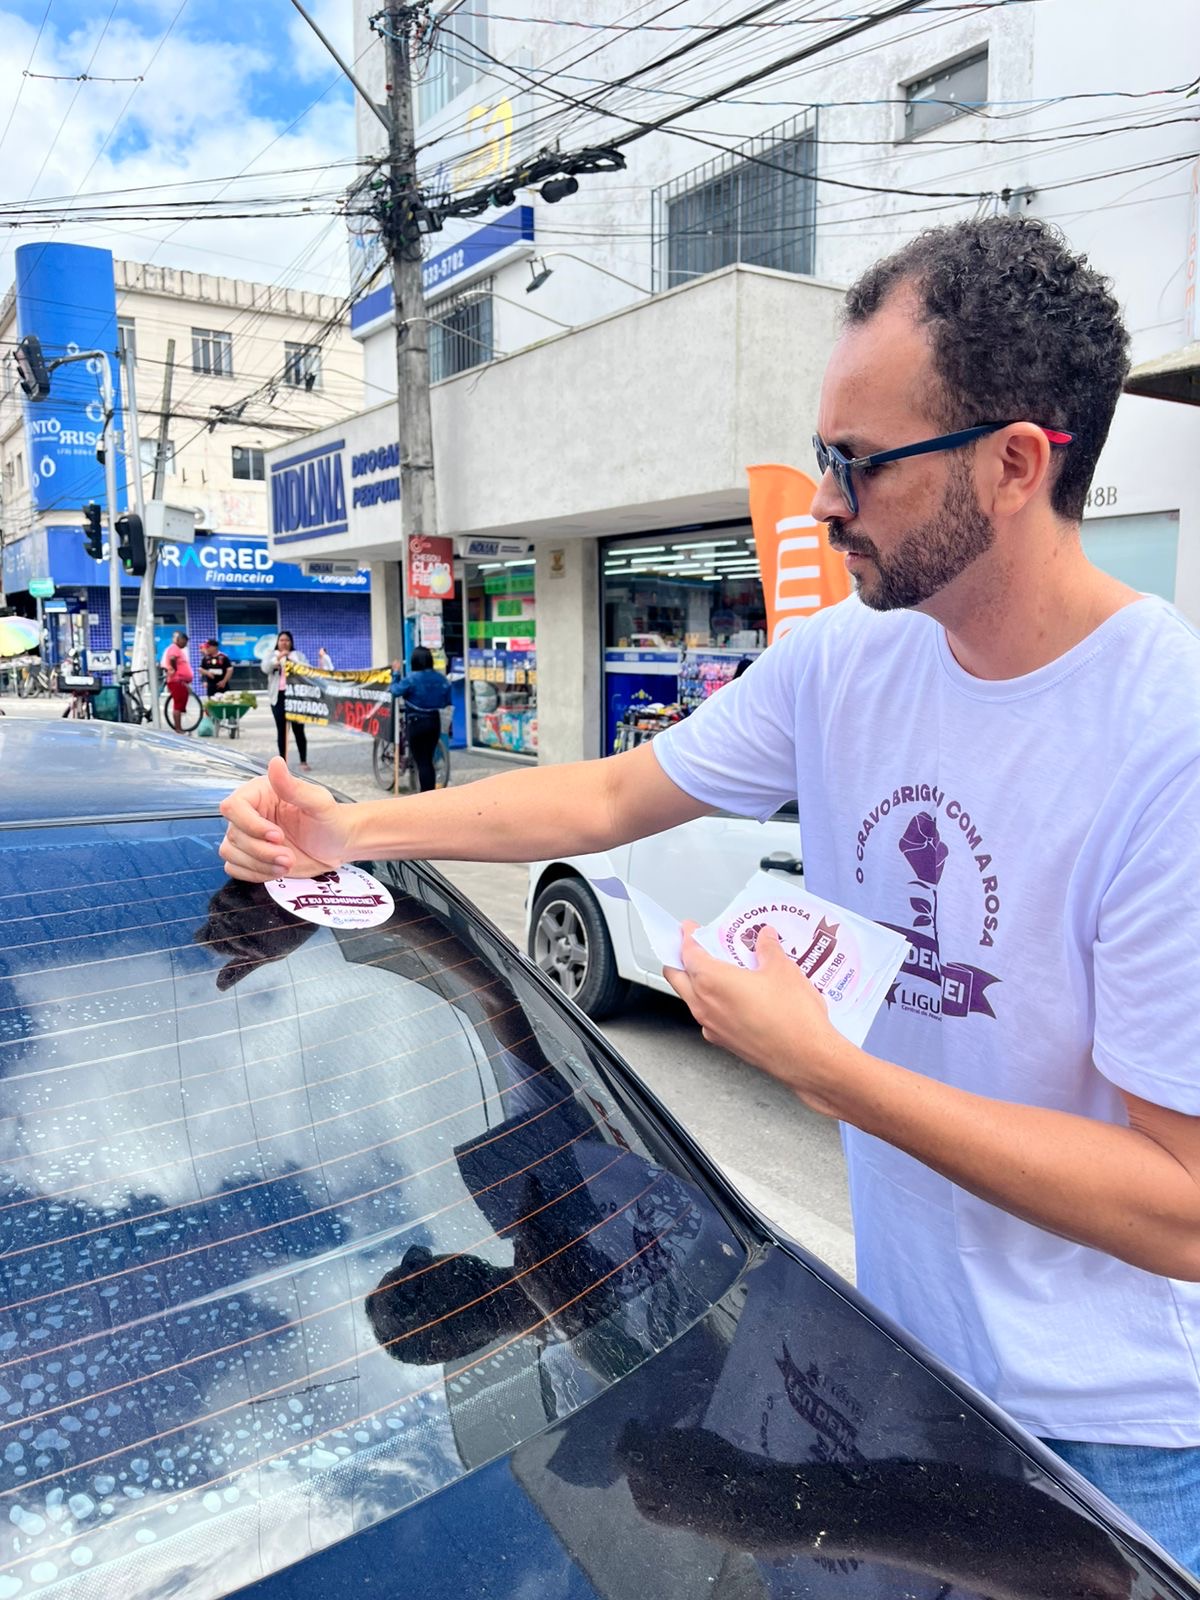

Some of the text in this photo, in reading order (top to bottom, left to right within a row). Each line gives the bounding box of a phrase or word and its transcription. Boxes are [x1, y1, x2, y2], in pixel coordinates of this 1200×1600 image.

[271, 452, 348, 535] INDIANA
[204, 571, 275, 585] Financeira
[857, 799, 890, 861] CRAVO
[946, 800, 983, 850] COM
[856, 867, 864, 884] O
[974, 854, 992, 872] A
[743, 905, 769, 920] COM
[771, 904, 779, 912] A
[781, 904, 811, 921] ROSA
[979, 875, 1000, 947] ROSA
